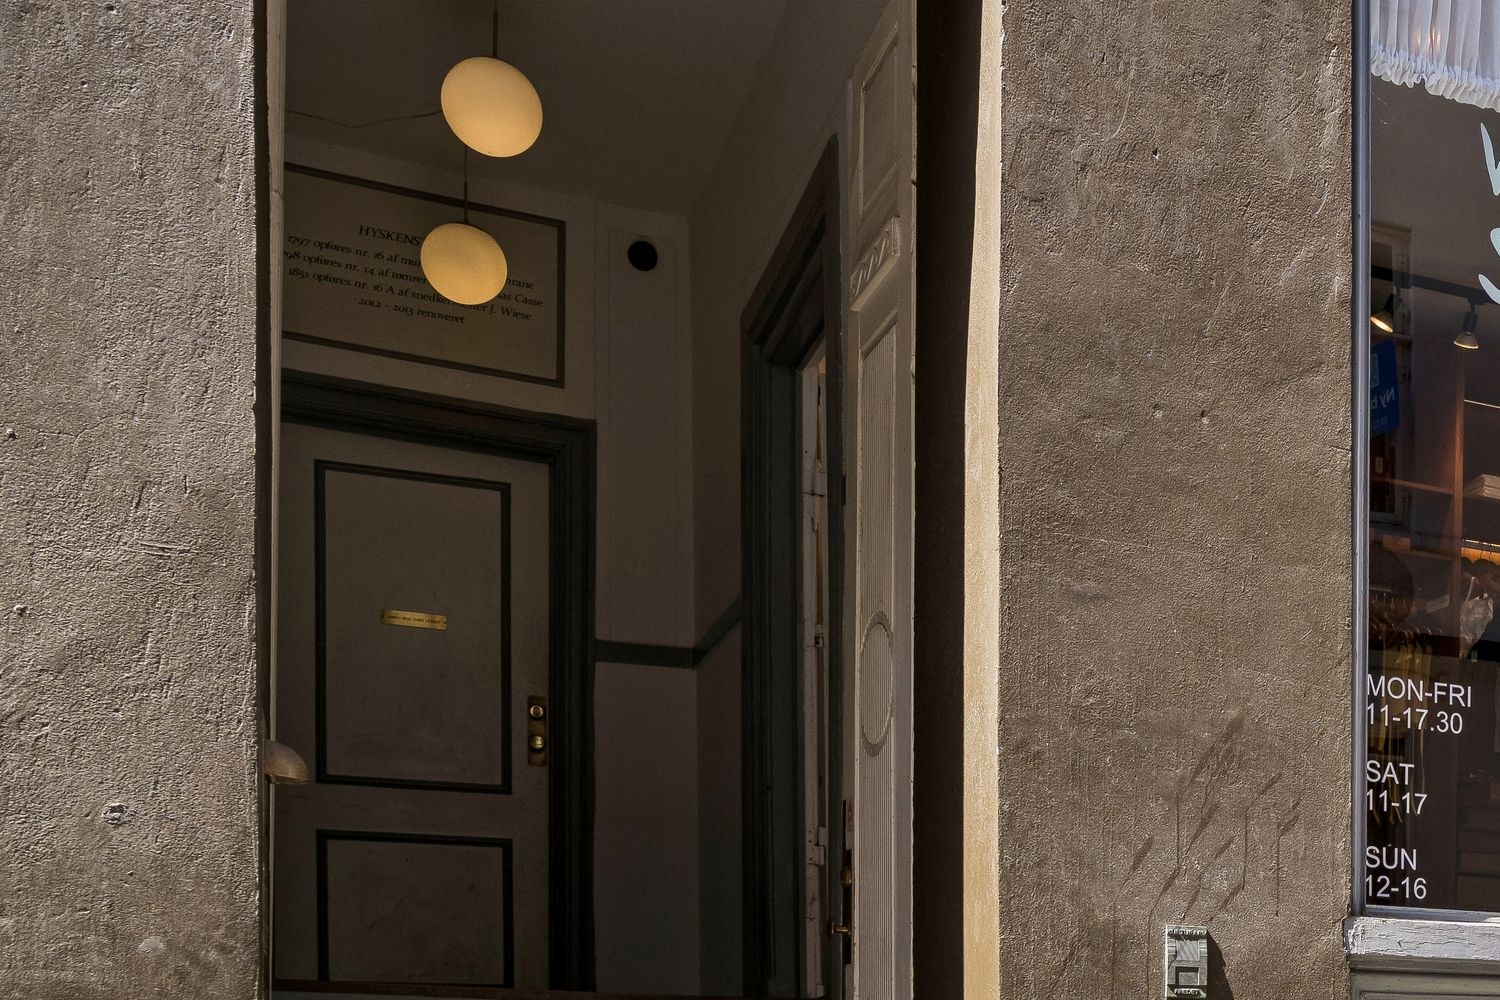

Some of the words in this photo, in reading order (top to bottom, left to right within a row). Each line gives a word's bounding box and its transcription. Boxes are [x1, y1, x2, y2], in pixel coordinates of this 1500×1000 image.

[359, 224, 424, 247] HYSKENS
[1367, 674, 1472, 707] MON-FRI
[1367, 703, 1463, 734] 11-17.30
[1366, 759, 1415, 785] SAT
[1366, 789, 1428, 815] 11-17
[1365, 845, 1417, 870] SUN
[1365, 874, 1427, 900] 12-16
